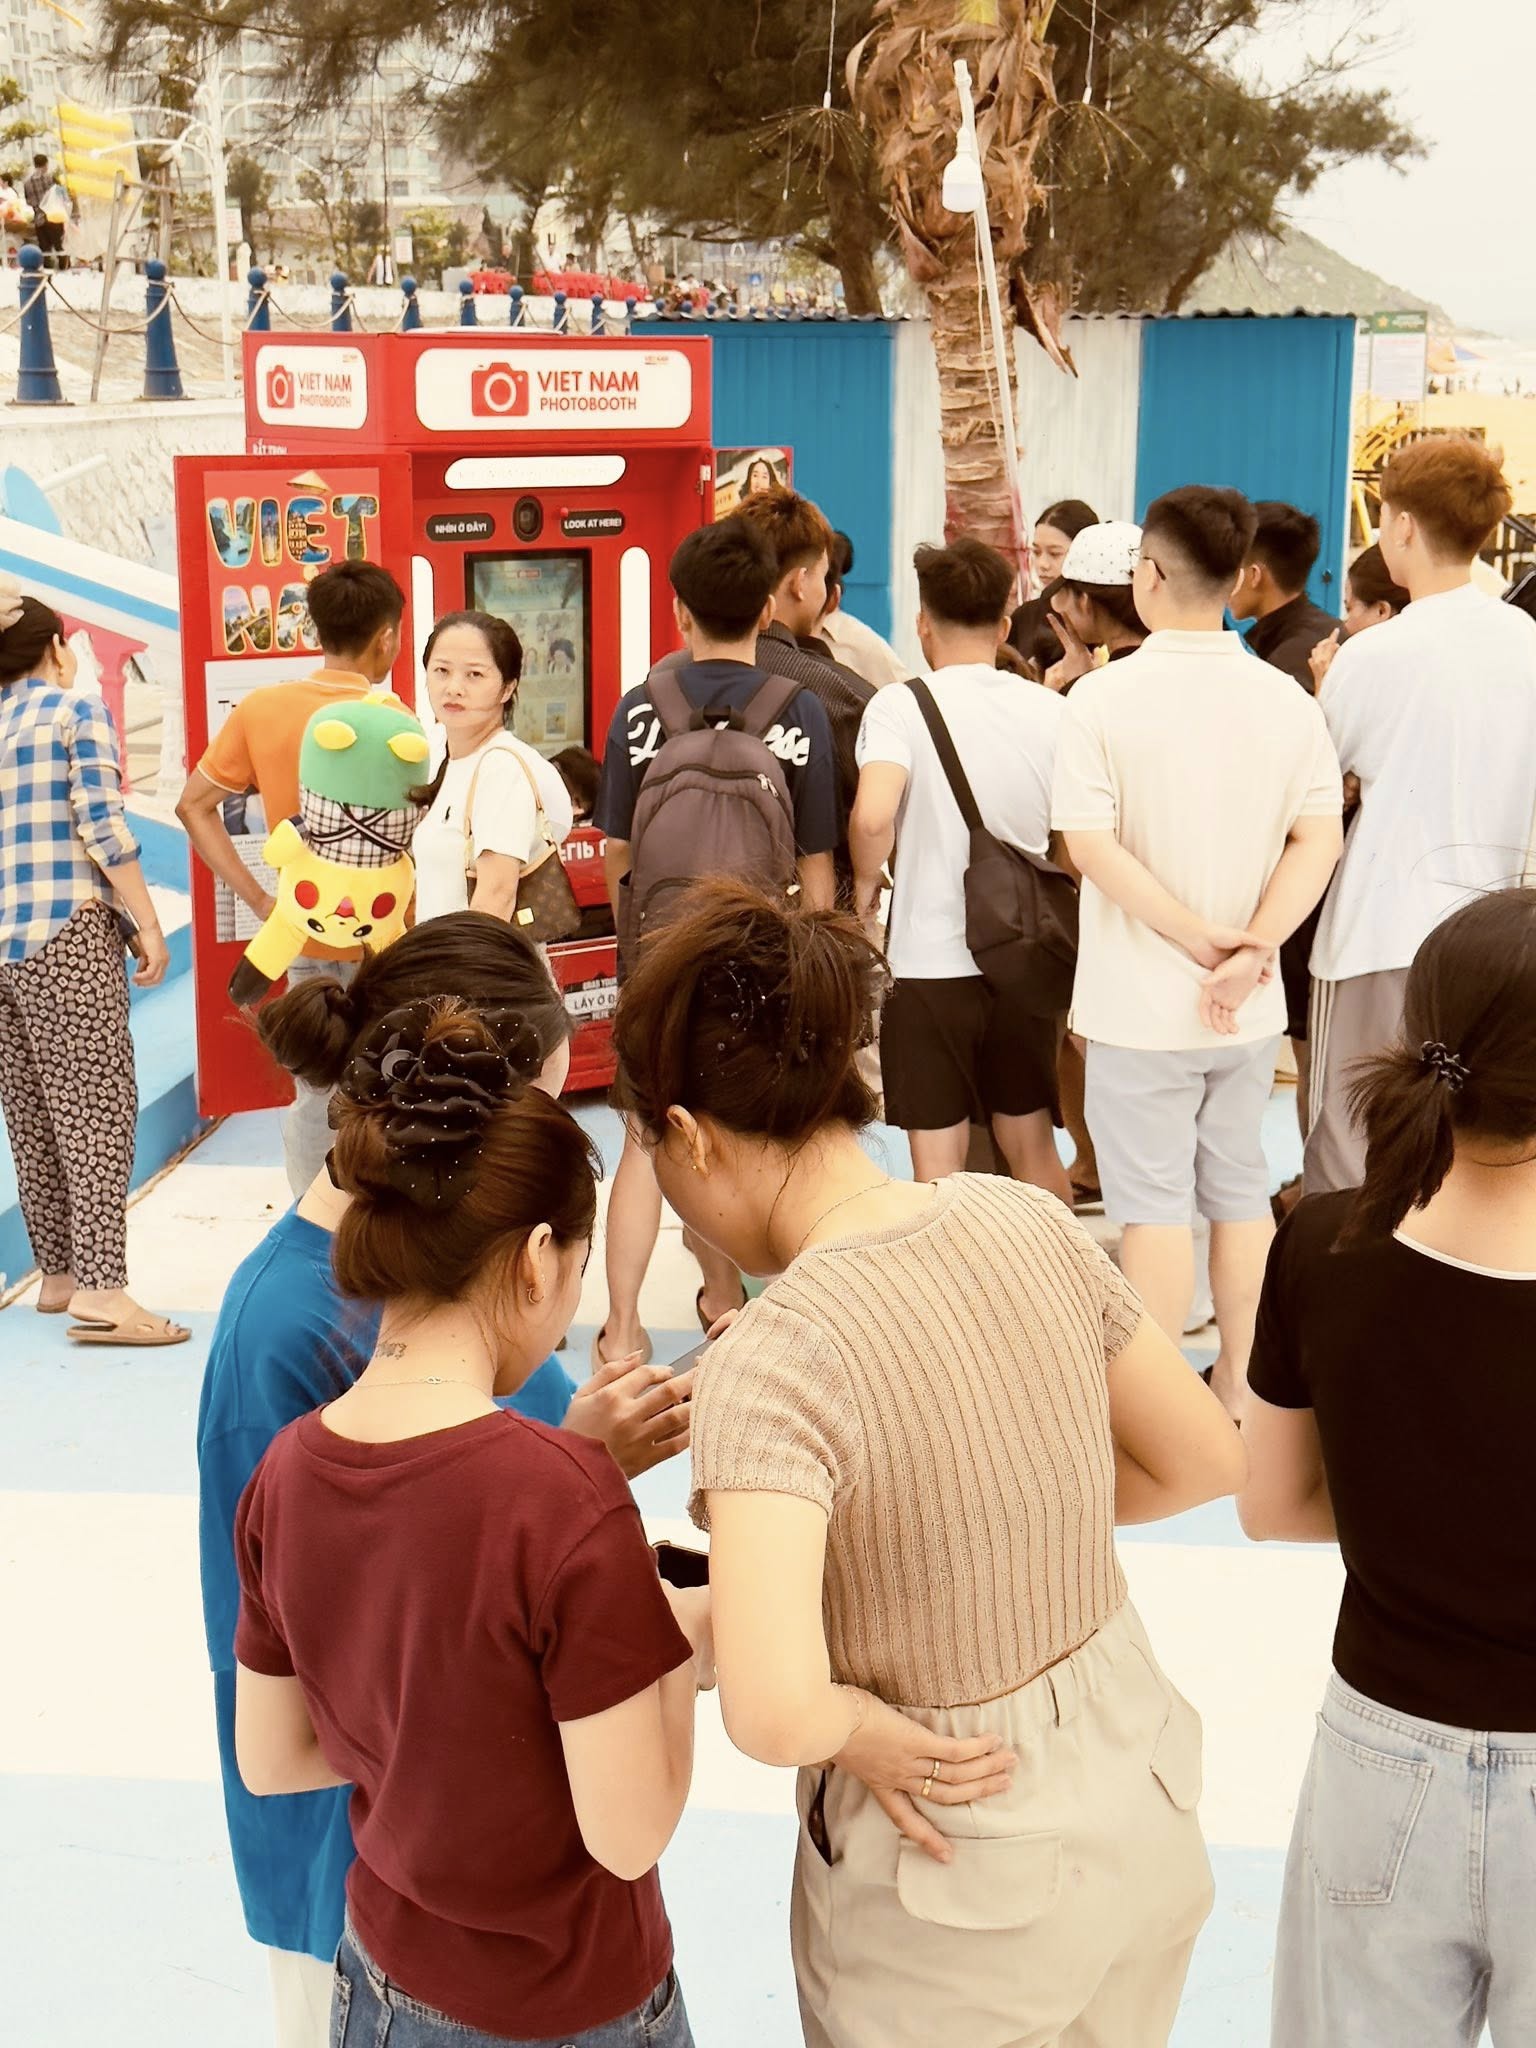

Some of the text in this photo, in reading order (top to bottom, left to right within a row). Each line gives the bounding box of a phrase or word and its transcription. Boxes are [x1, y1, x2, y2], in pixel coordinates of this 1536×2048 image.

[298, 372, 352, 392] VIET NAM
[537, 371, 640, 392] VIET NAM
[300, 394, 352, 408] PHOTOBOOTH
[540, 397, 637, 411] PHOTOBOOTH
[564, 518, 622, 529] LOOK AT HERE!
[222, 582, 322, 655] NA
